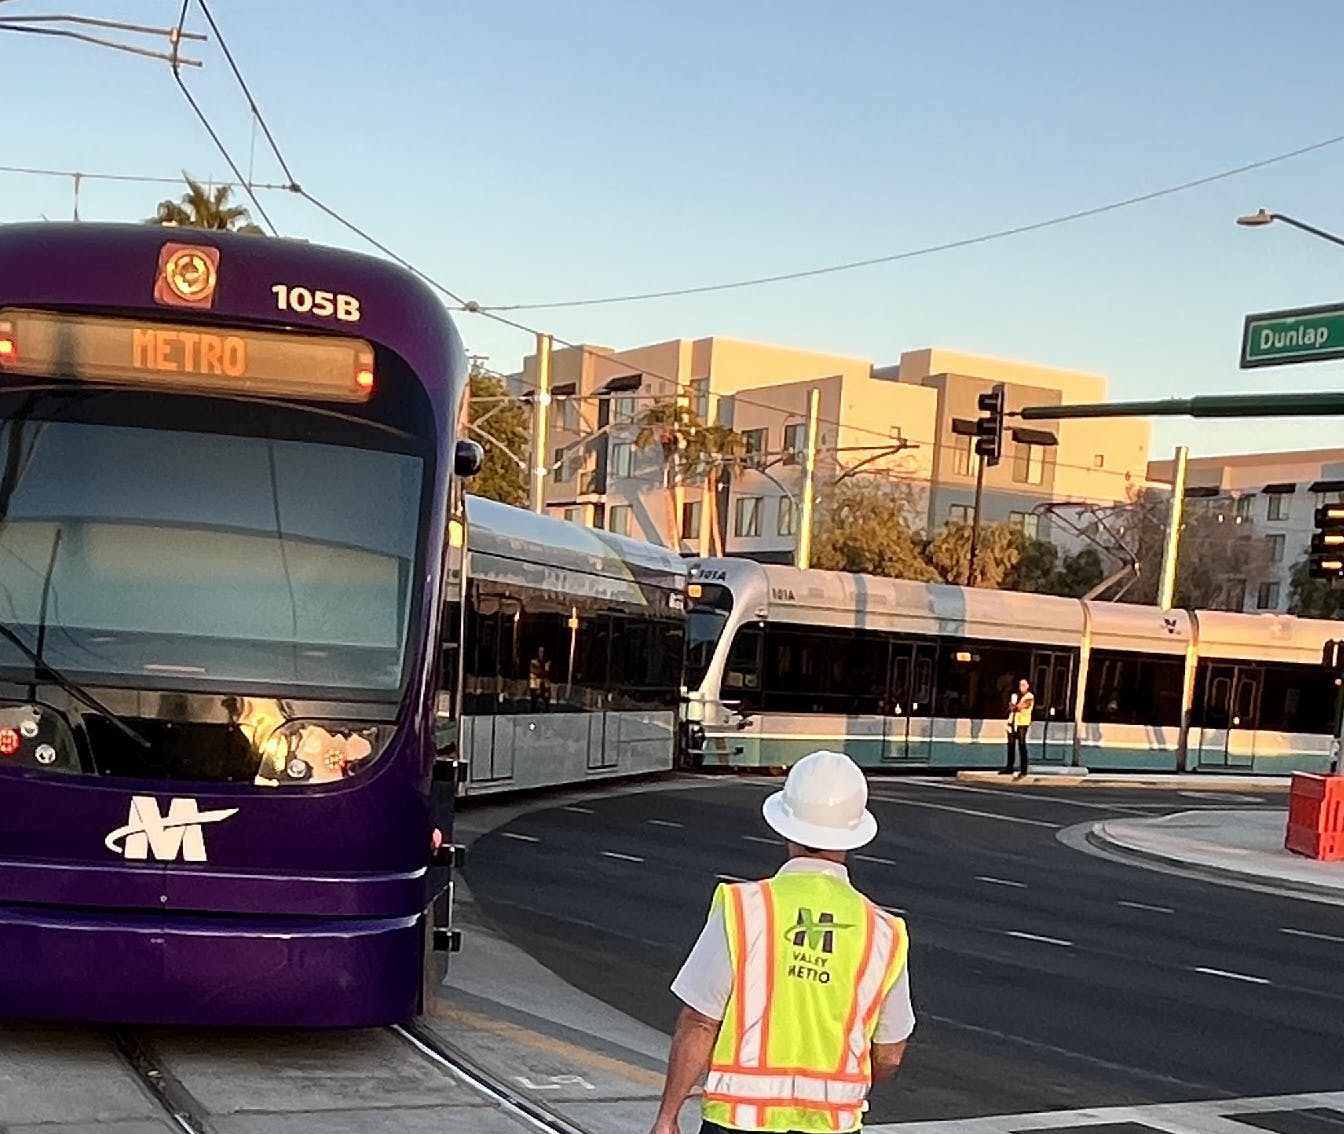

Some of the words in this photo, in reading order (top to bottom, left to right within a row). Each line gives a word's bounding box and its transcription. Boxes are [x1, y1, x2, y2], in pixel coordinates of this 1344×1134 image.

[272, 284, 361, 322] 105B
[133, 328, 246, 376] METRO
[1259, 326, 1329, 349] Dunlap
